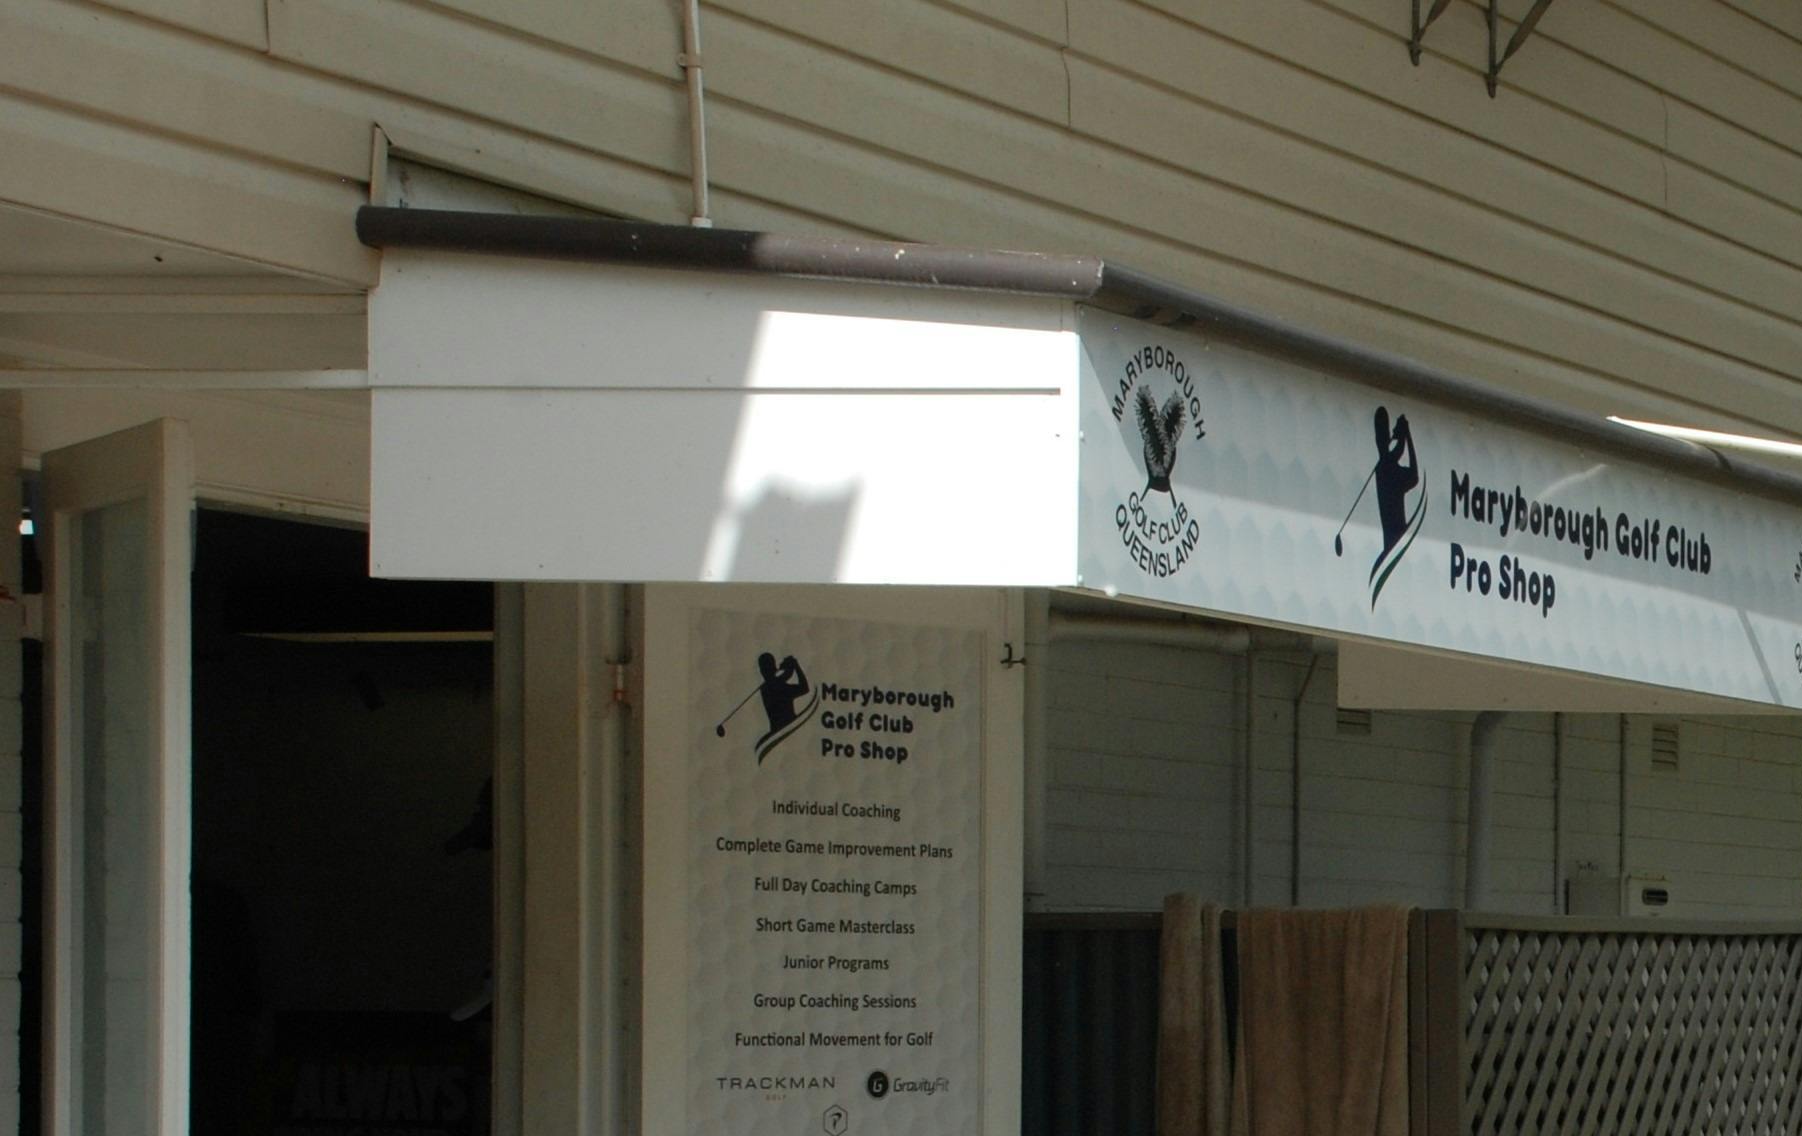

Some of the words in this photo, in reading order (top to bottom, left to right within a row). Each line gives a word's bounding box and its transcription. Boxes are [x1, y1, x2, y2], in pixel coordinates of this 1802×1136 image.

[1112, 346, 1206, 441] MARYBOROUGH
[1128, 491, 1157, 541] GOLF
[1158, 502, 1188, 545] CLUB
[1451, 468, 1608, 561] Maryborough
[1616, 512, 1660, 562] Golf
[1666, 525, 1711, 575] Club
[1115, 504, 1200, 578] QUEENSLAND
[1451, 542, 1491, 596] Pro
[1499, 554, 1556, 618] Shop
[821, 683, 954, 712] Maryborough
[821, 711, 863, 730] Golf
[869, 713, 913, 733] Club
[821, 738, 855, 757] Pro
[860, 741, 909, 764] Shop
[772, 800, 838, 817] Individual
[842, 802, 901, 822] Coaching
[716, 836, 782, 855] Complete
[785, 839, 825, 854] Game
[828, 840, 916, 858] Improvement
[919, 843, 954, 859] Plans
[754, 876, 779, 892] Full
[782, 877, 808, 895] Day
[811, 878, 871, 897] Coaching
[874, 880, 917, 897] Camps
[756, 917, 793, 933] Short
[796, 918, 835, 933] Game
[839, 919, 915, 935] Masterclass
[783, 955, 824, 970] Junior
[828, 956, 889, 973] Programs
[754, 993, 796, 1010] Group
[799, 993, 859, 1011] Coaching
[862, 994, 917, 1009] Sessions
[735, 1032, 806, 1047] Functional
[809, 1032, 881, 1047] Movement
[884, 1031, 903, 1047] for
[906, 1031, 934, 1046] Golf
[716, 1076, 836, 1090] TRACKMAN
